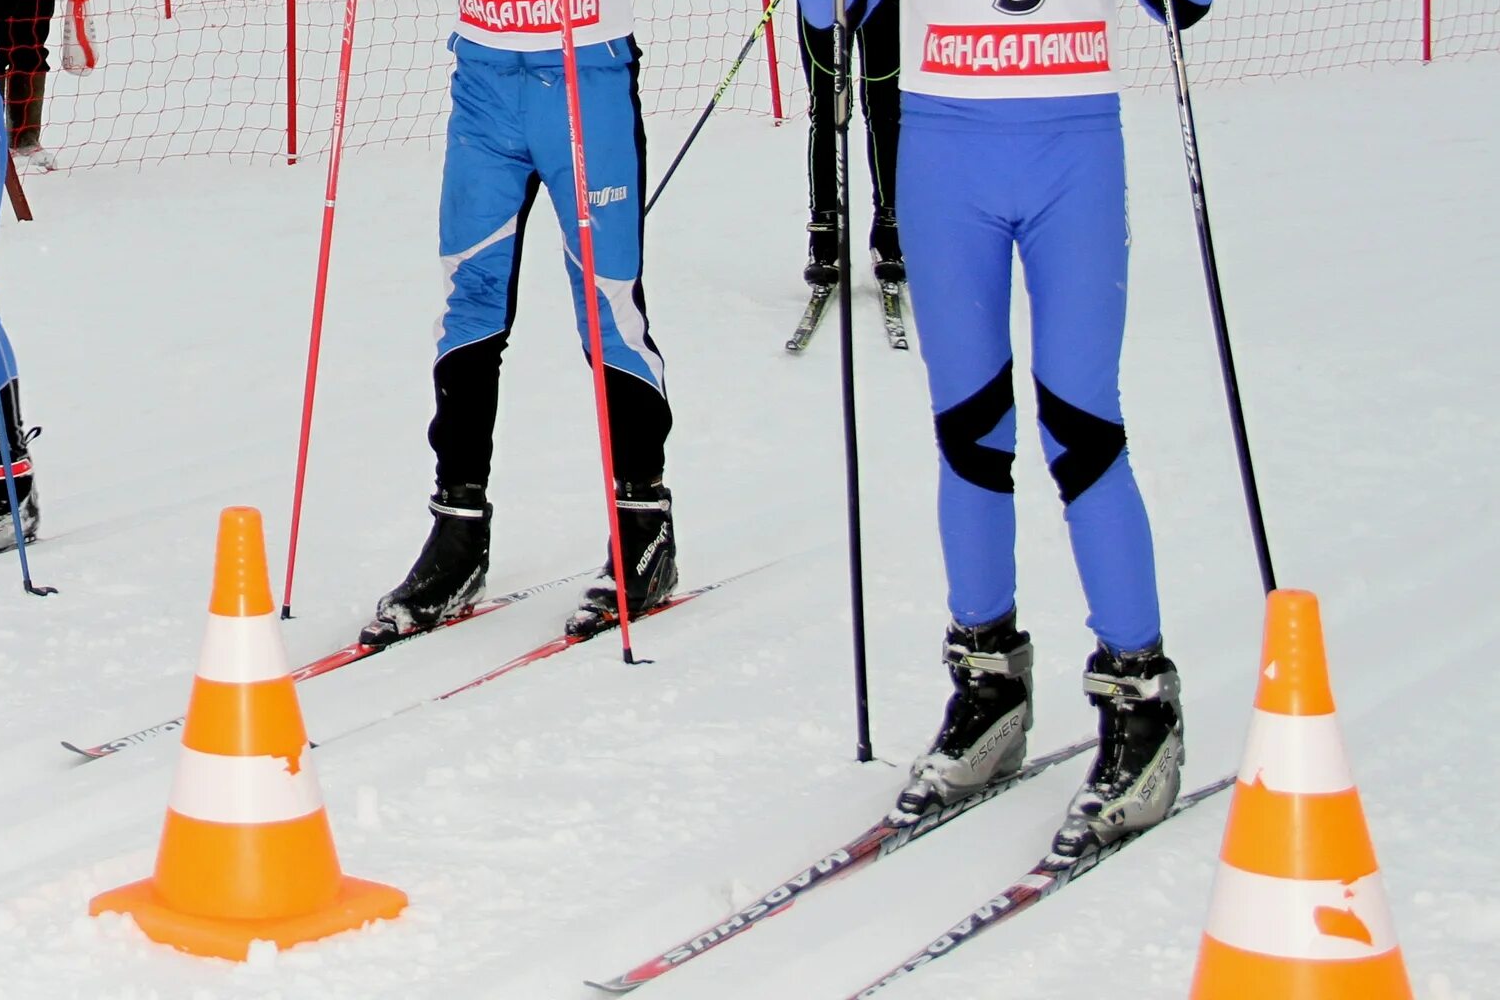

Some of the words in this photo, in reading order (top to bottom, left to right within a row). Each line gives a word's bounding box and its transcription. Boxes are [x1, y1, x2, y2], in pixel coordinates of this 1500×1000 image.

[927, 31, 1107, 72] КАНДАЛАКША
[969, 714, 1020, 772] FISCHER
[663, 848, 850, 965] MADSHUS
